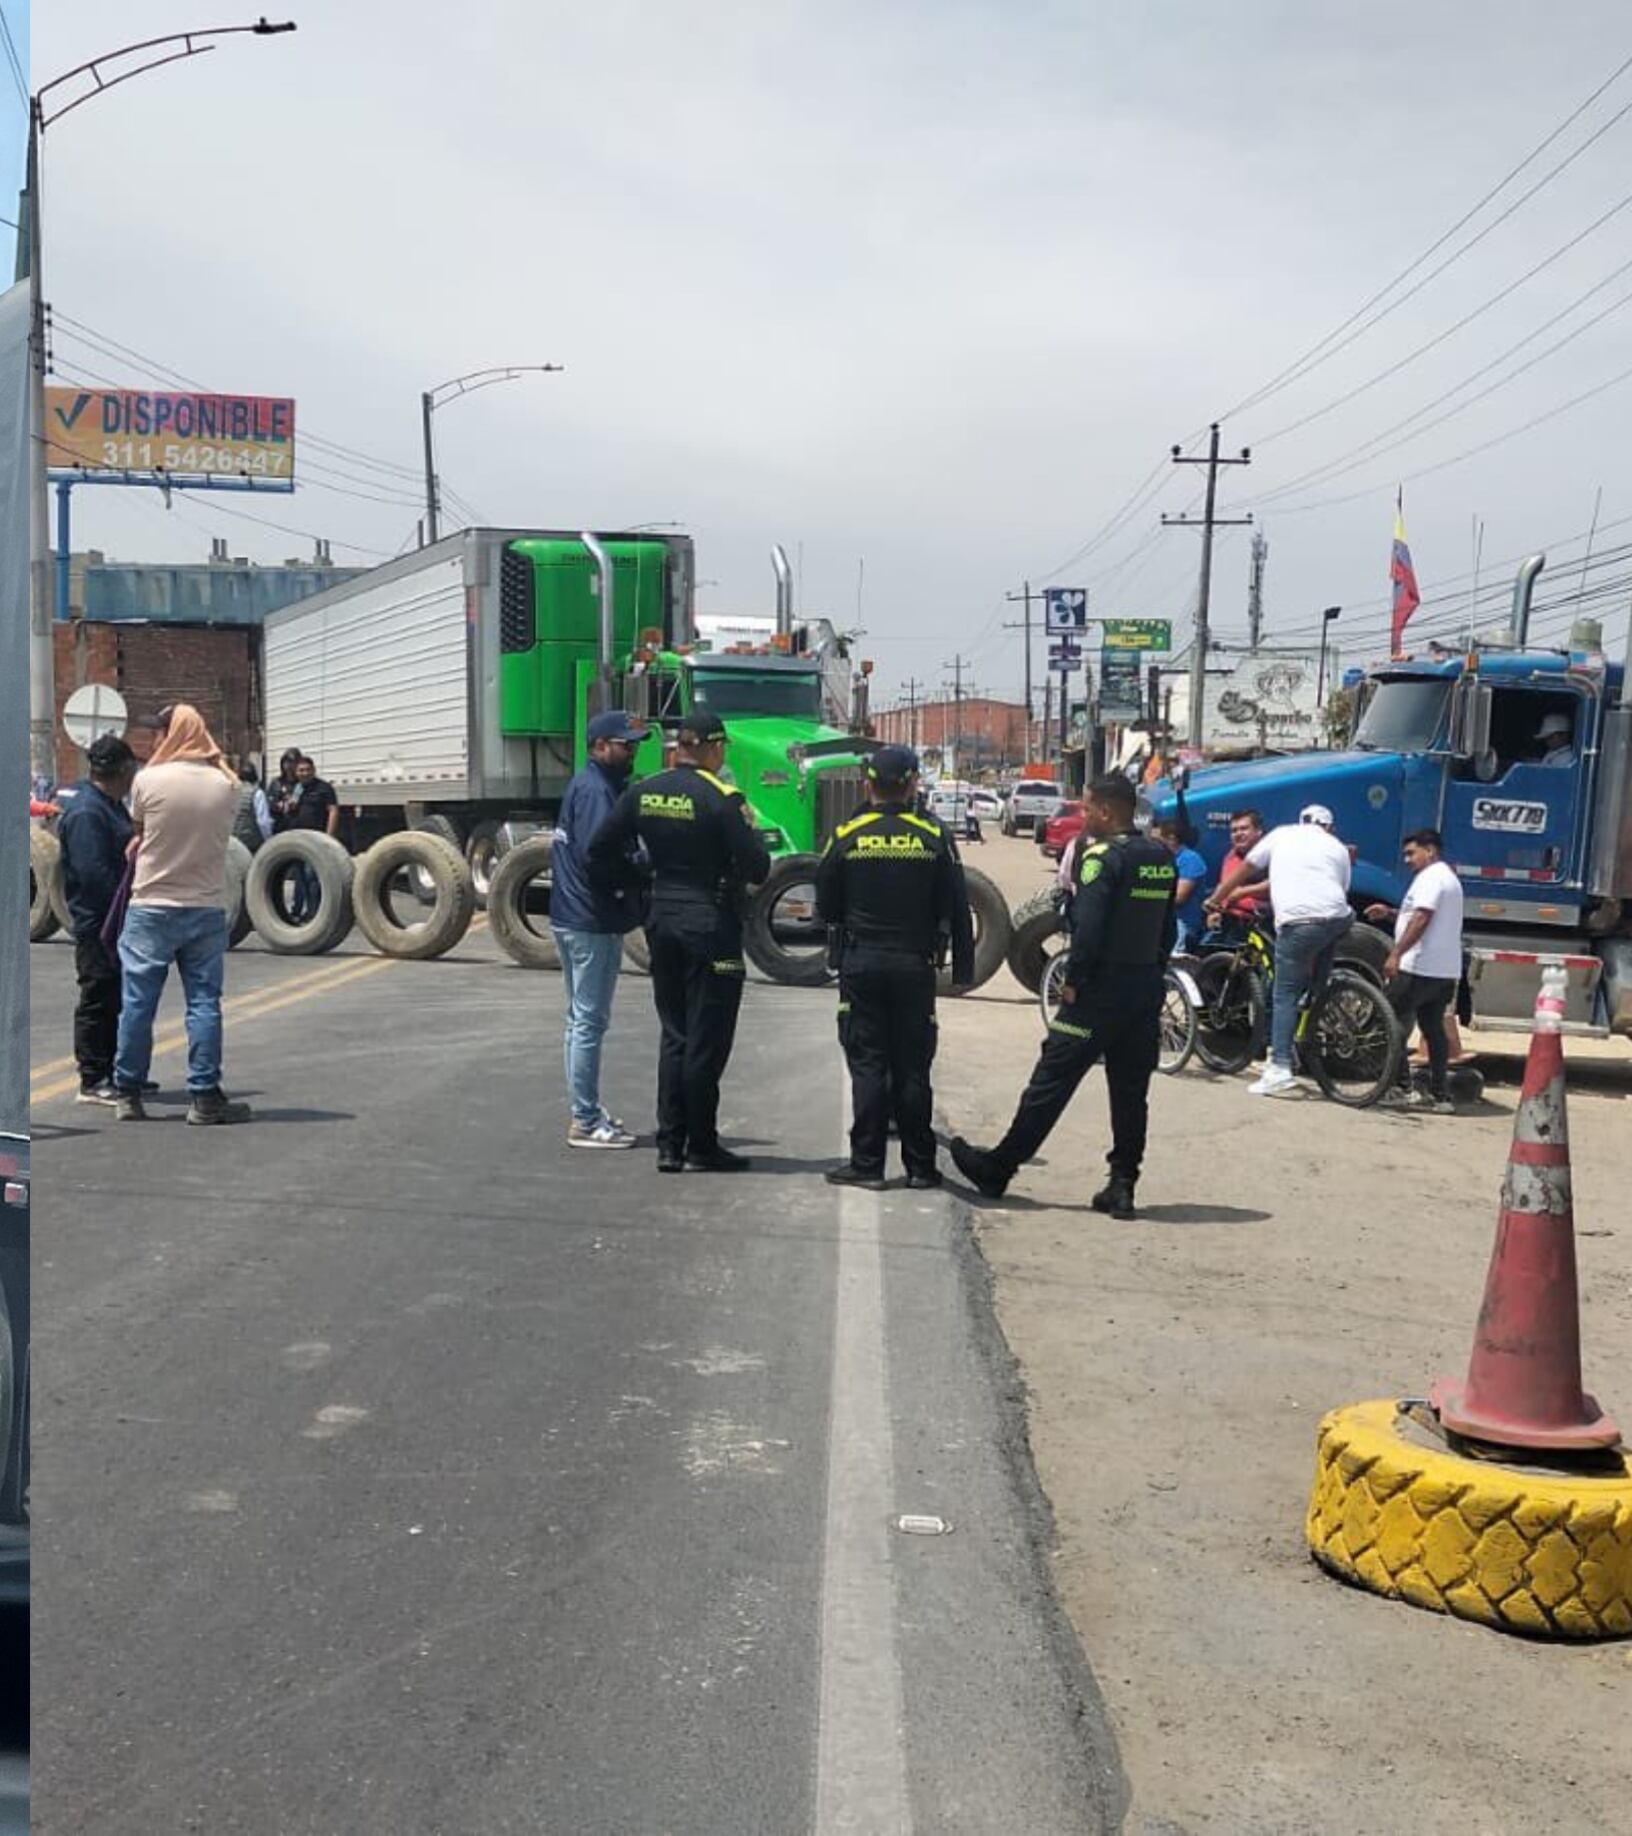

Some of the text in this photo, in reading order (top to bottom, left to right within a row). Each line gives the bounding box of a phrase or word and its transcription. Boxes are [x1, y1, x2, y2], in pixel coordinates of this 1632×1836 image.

[101, 394, 288, 443] DISPONIBLE
[101, 441, 152, 467] 311
[640, 793, 693, 811] POLICÍA
[856, 832, 925, 851] POLICÍA
